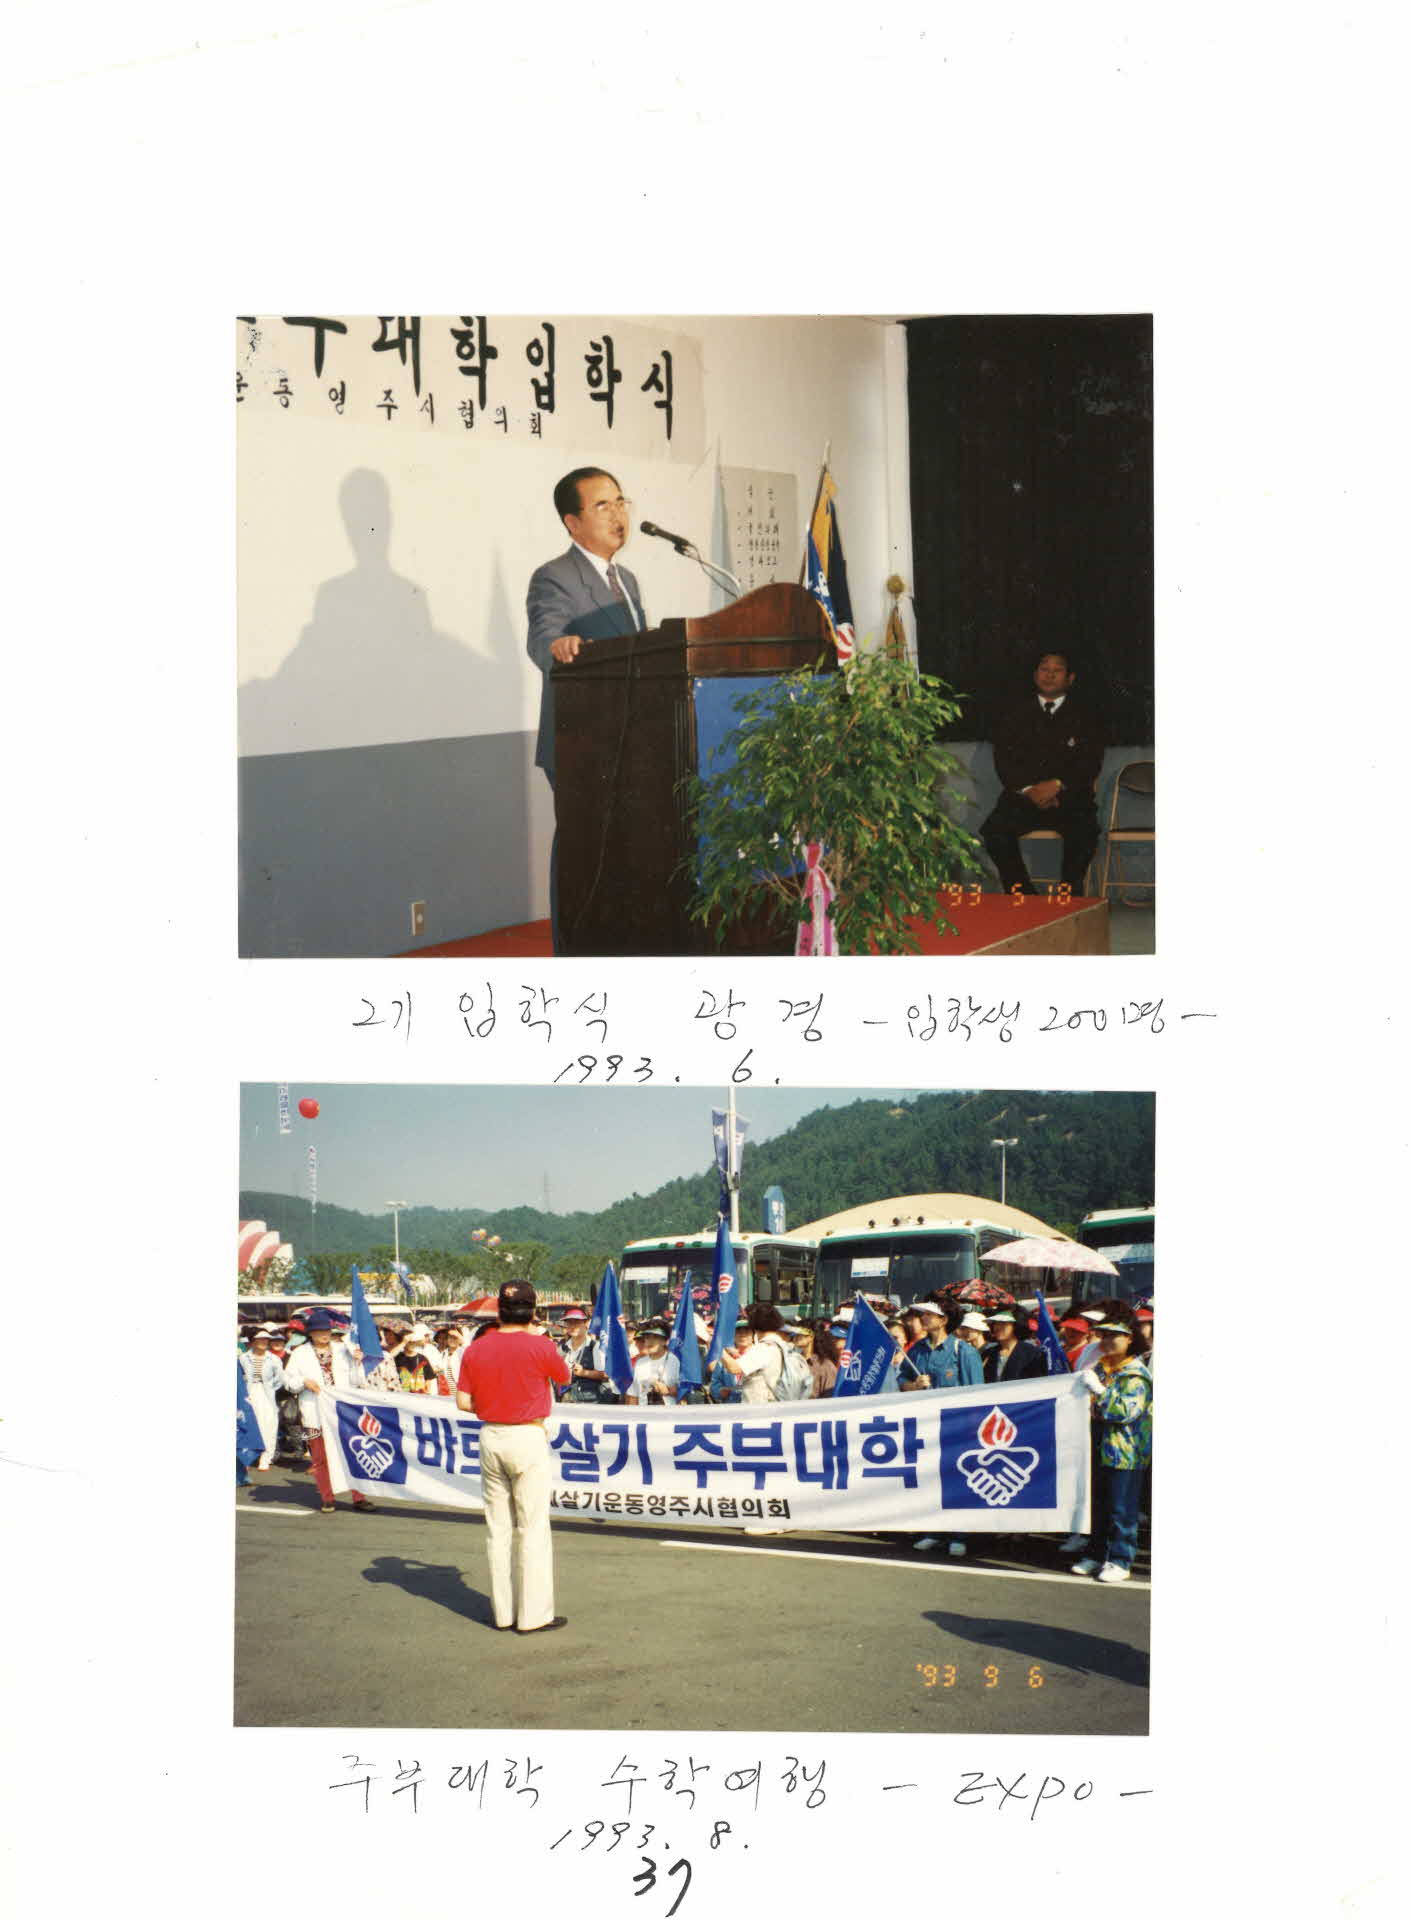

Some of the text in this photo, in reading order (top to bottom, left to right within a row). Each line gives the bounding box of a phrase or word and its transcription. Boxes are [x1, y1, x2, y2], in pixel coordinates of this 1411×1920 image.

[353, 991, 411, 1039] 2기
[459, 982, 608, 1044] 입학식
[673, 1415, 924, 1490] 주부대학
[329, 1755, 544, 1814] 주부대학
[600, 1754, 827, 1813] 수학여행
[632, 1856, 692, 1918] 37
